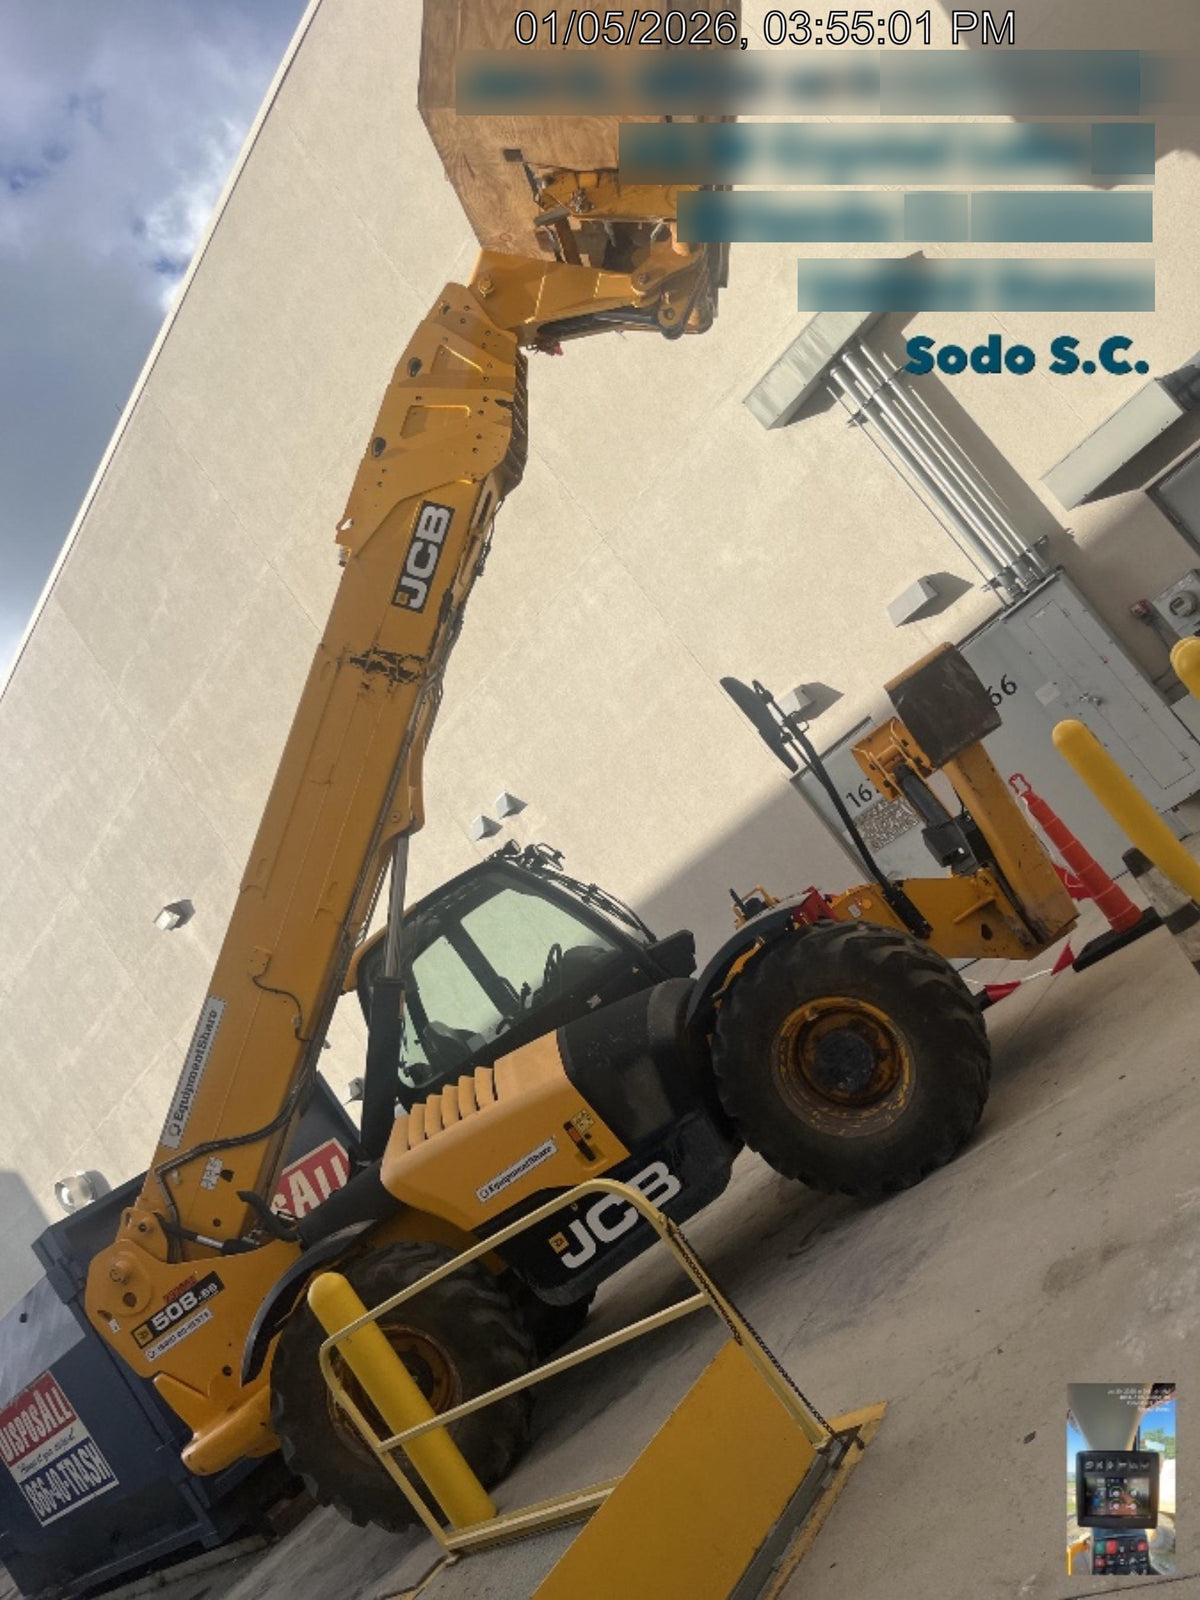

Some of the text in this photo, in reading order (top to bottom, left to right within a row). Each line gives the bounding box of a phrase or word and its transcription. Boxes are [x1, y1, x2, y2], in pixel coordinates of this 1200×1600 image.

[399, 505, 450, 609] JCB
[846, 782, 876, 809] 16
[173, 1009, 218, 1123] EquipmentShare
[560, 1161, 682, 1269] JCB
[0, 1386, 74, 1462] DISPOSALL
